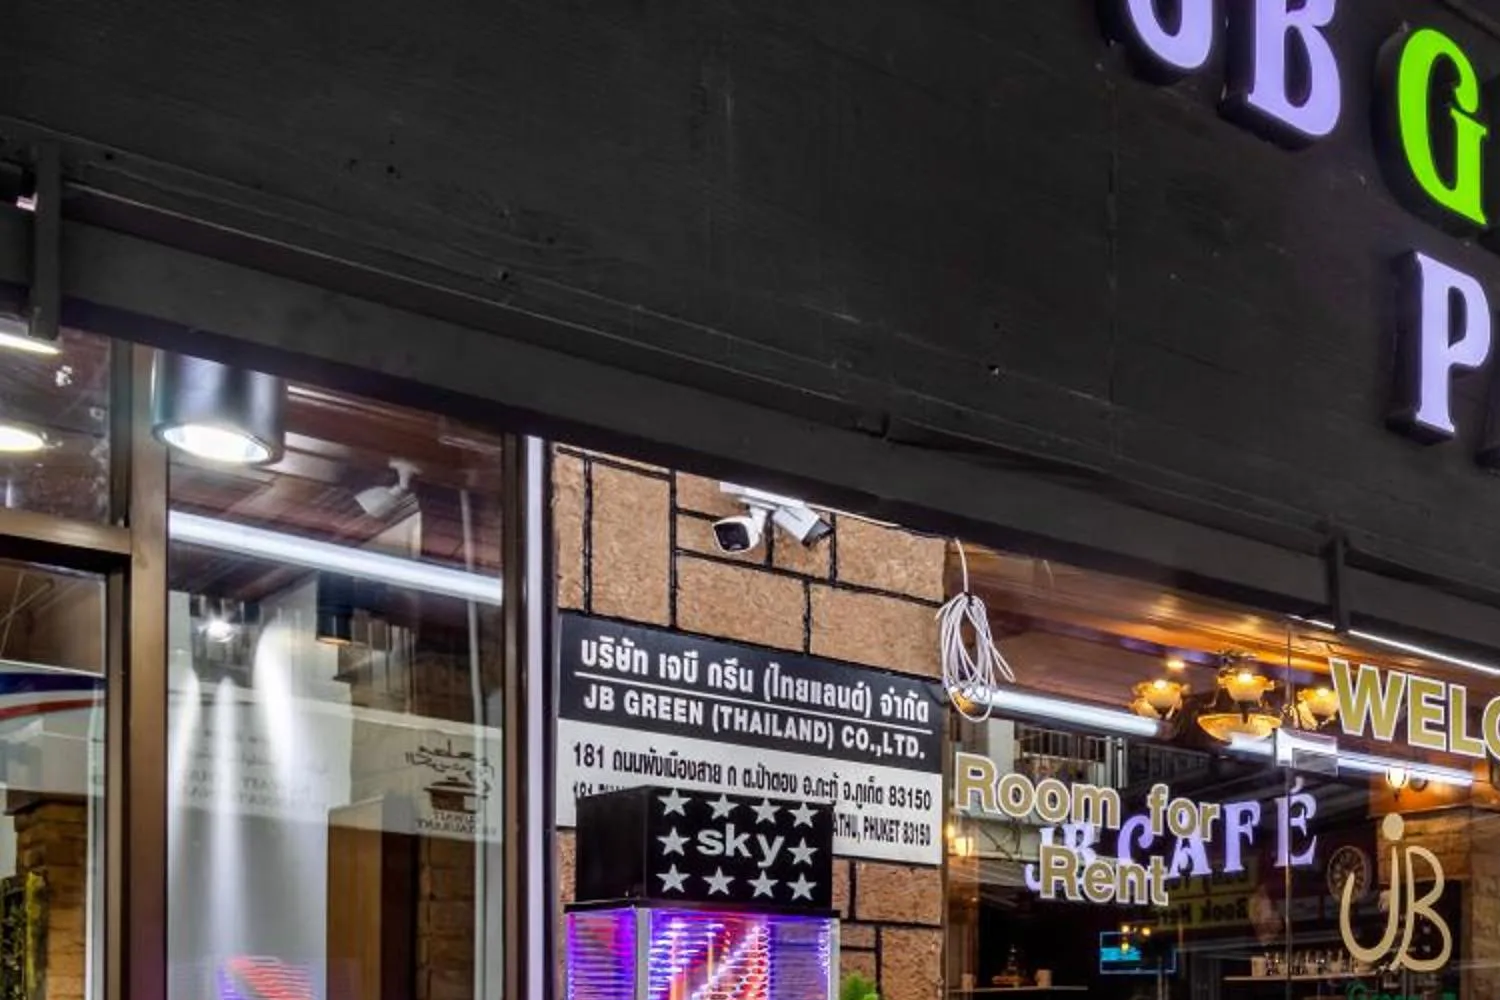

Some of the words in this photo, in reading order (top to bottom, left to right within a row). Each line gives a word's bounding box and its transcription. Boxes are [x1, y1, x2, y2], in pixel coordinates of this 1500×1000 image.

[581, 635, 649, 676] บริษัท
[880, 686, 929, 723] จำกัด
[583, 684, 616, 711] JB
[623, 690, 704, 725] GREEN
[712, 703, 834, 750] (THAILAND)
[841, 725, 926, 760] CO.,LTD.
[573, 741, 605, 769] 181
[889, 785, 932, 812] 83150
[955, 750, 1121, 830] Room
[1147, 783, 1221, 843] for
[696, 823, 785, 869] sky
[1040, 844, 1169, 906] Rent
